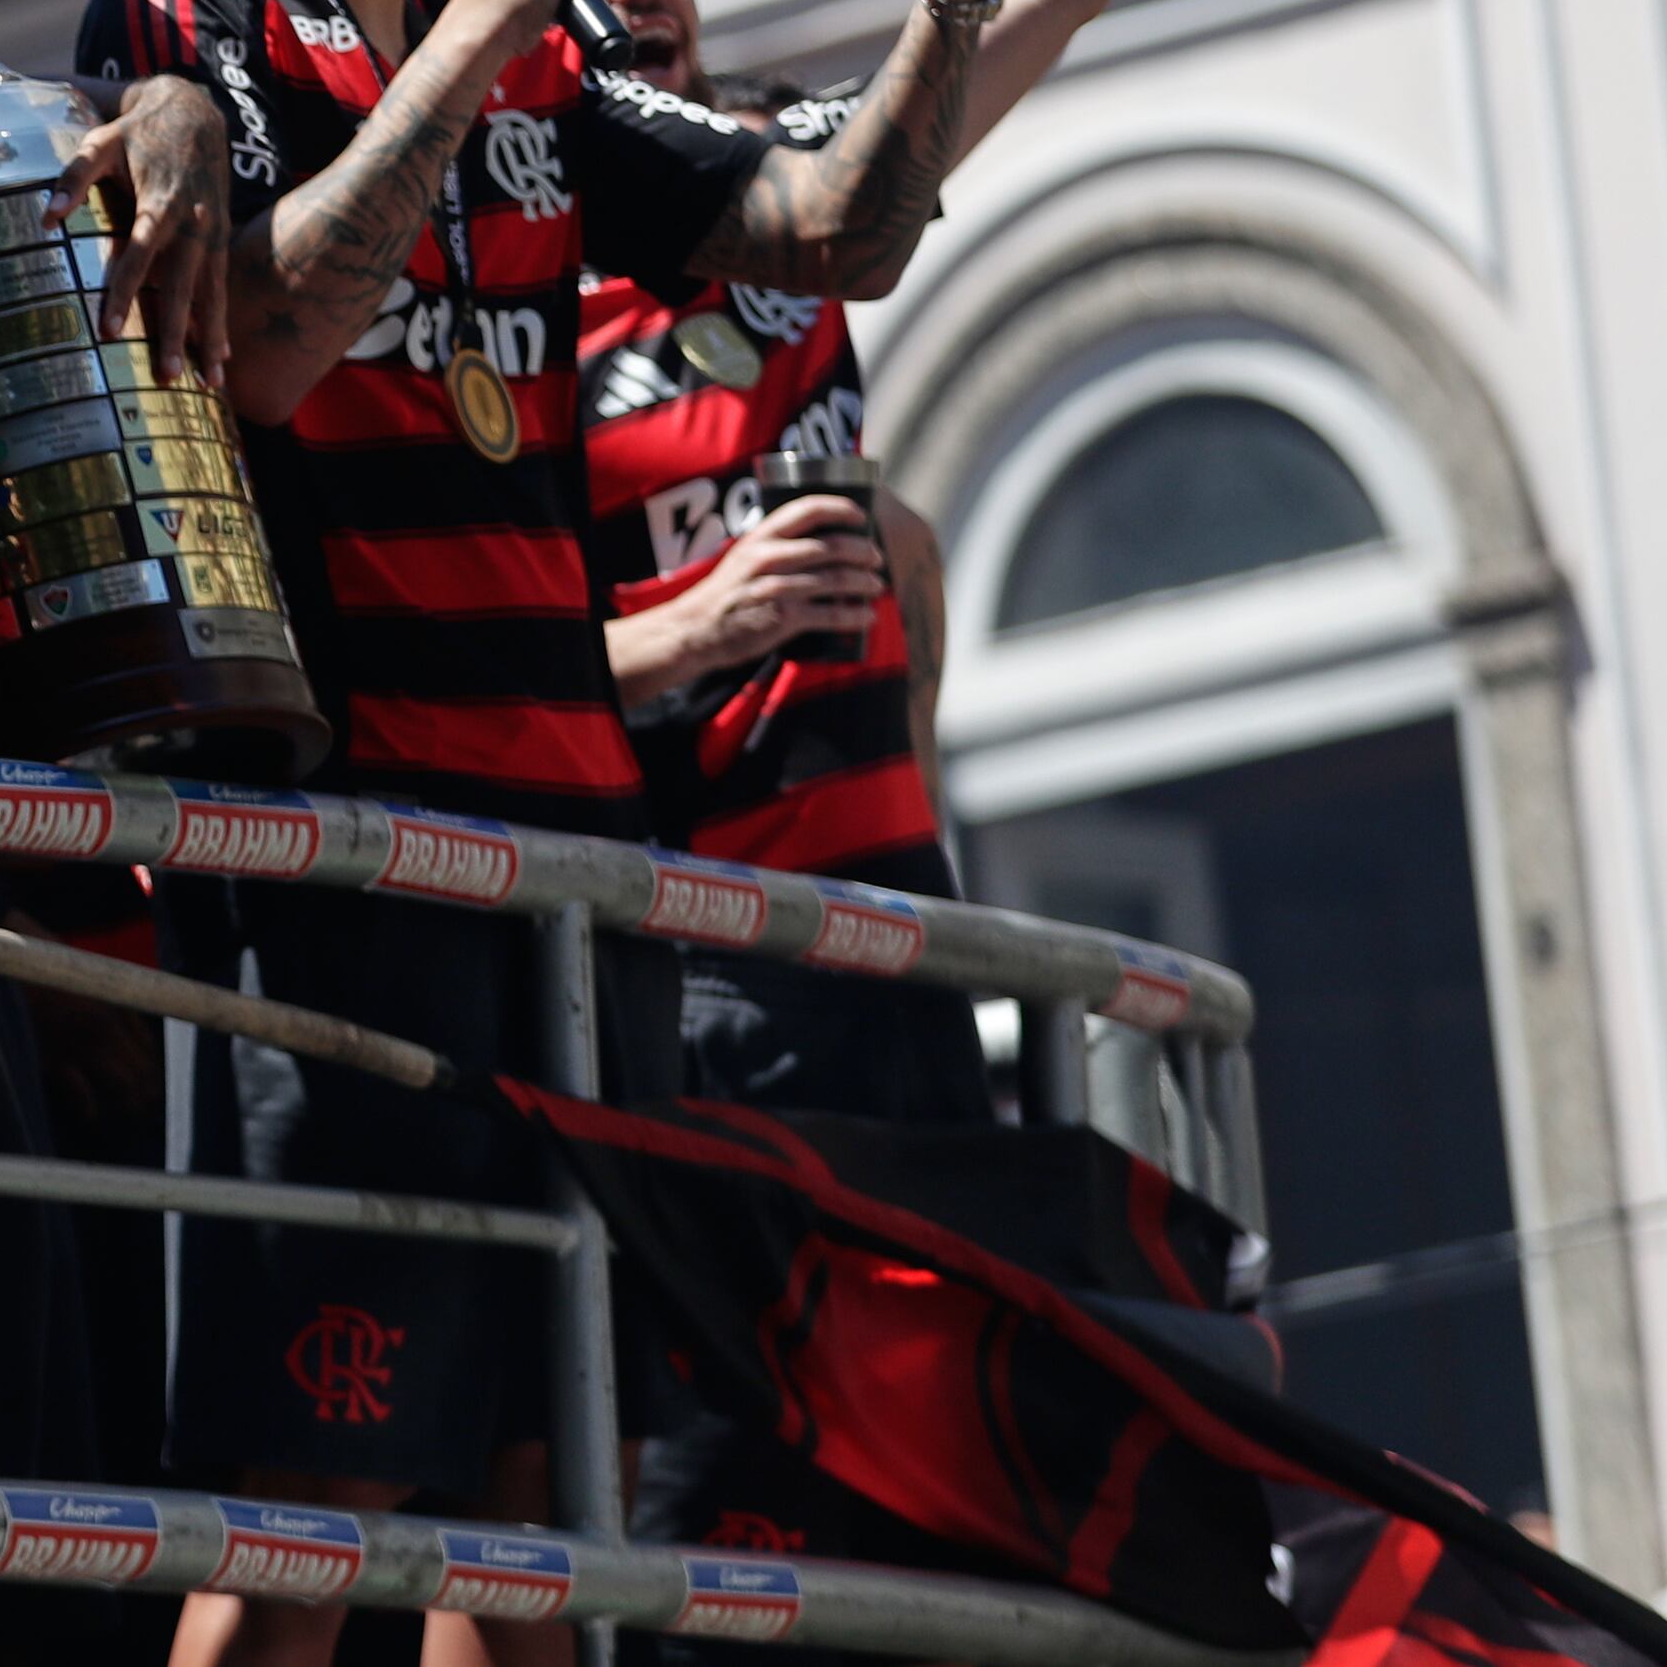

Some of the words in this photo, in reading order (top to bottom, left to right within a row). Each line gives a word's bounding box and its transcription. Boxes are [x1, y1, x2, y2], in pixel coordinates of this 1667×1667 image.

[174, 814, 310, 874] BRAHMA
[388, 829, 511, 899] BRAHMA
[6, 1534, 145, 1582] BRAHMA
[217, 1542, 352, 1596] BRAHMA
